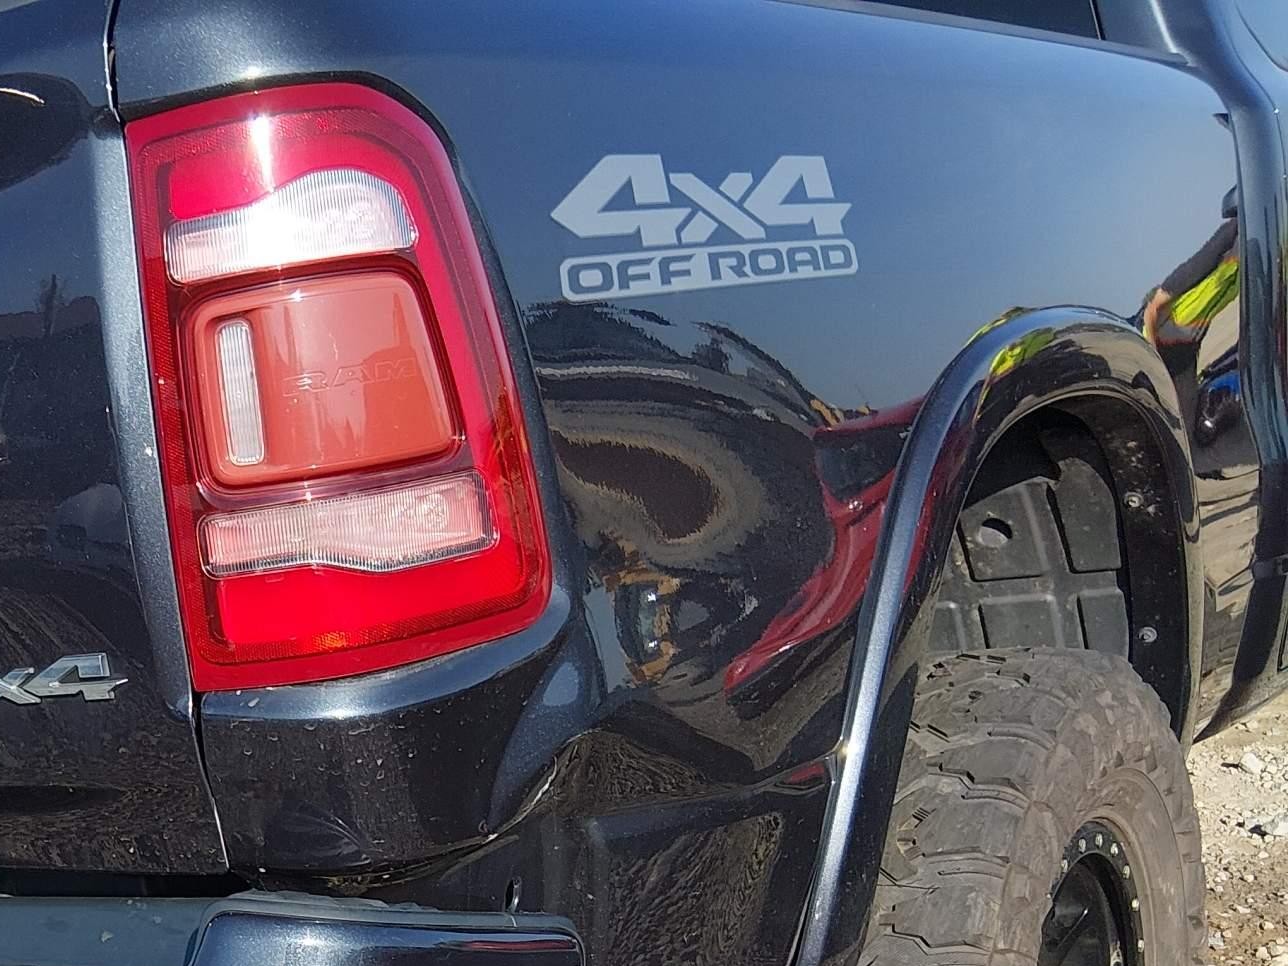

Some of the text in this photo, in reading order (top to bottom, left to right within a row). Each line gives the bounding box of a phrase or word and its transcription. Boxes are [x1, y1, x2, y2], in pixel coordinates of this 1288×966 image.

[567, 244, 852, 295] OFF ROAD
[281, 356, 419, 398] RAM
